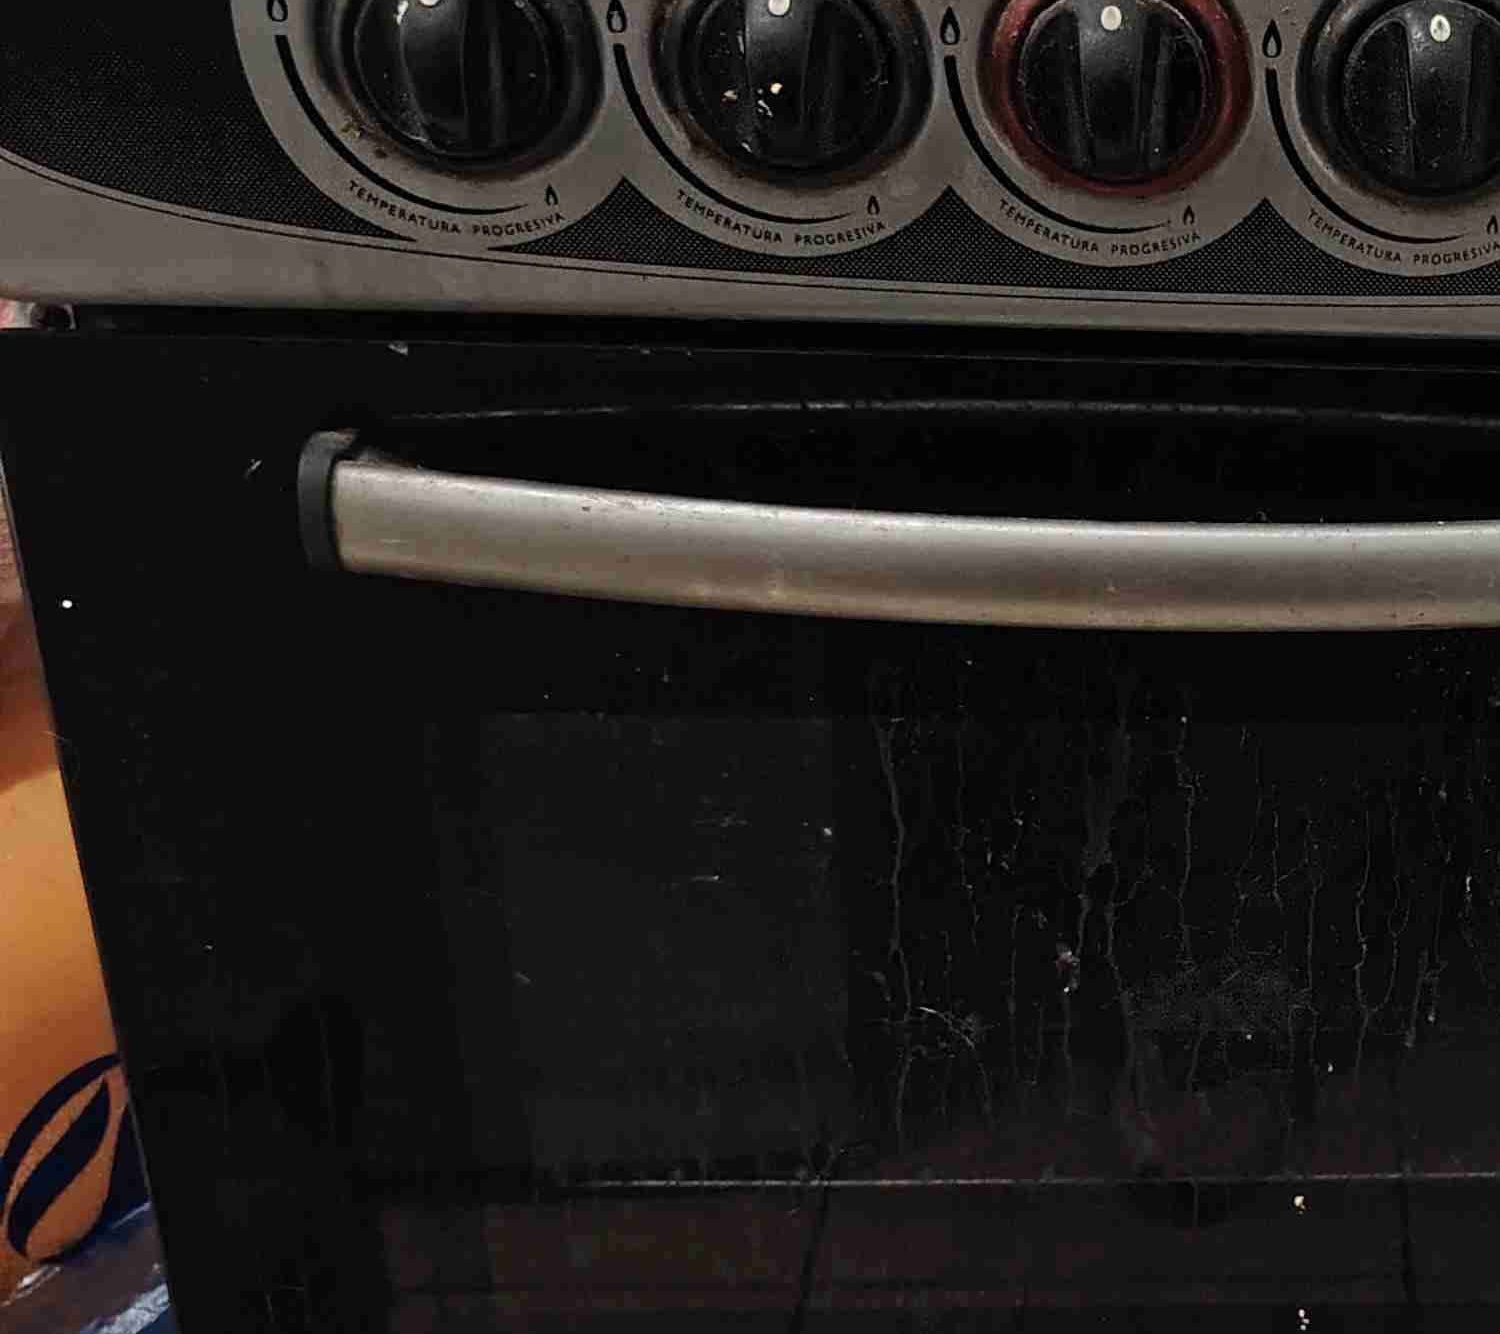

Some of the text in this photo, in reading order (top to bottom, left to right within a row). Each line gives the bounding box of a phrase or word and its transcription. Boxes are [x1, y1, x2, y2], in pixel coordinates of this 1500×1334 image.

[349, 180, 565, 236] TEMPERATURA PROGRESIVA
[677, 188, 886, 245] TEMPERATURA PROGRESIVA
[999, 198, 1201, 256] TEMPERATURA PROGRESIVA
[1307, 207, 1500, 265] TEMPERATURA PROGRESIVA
